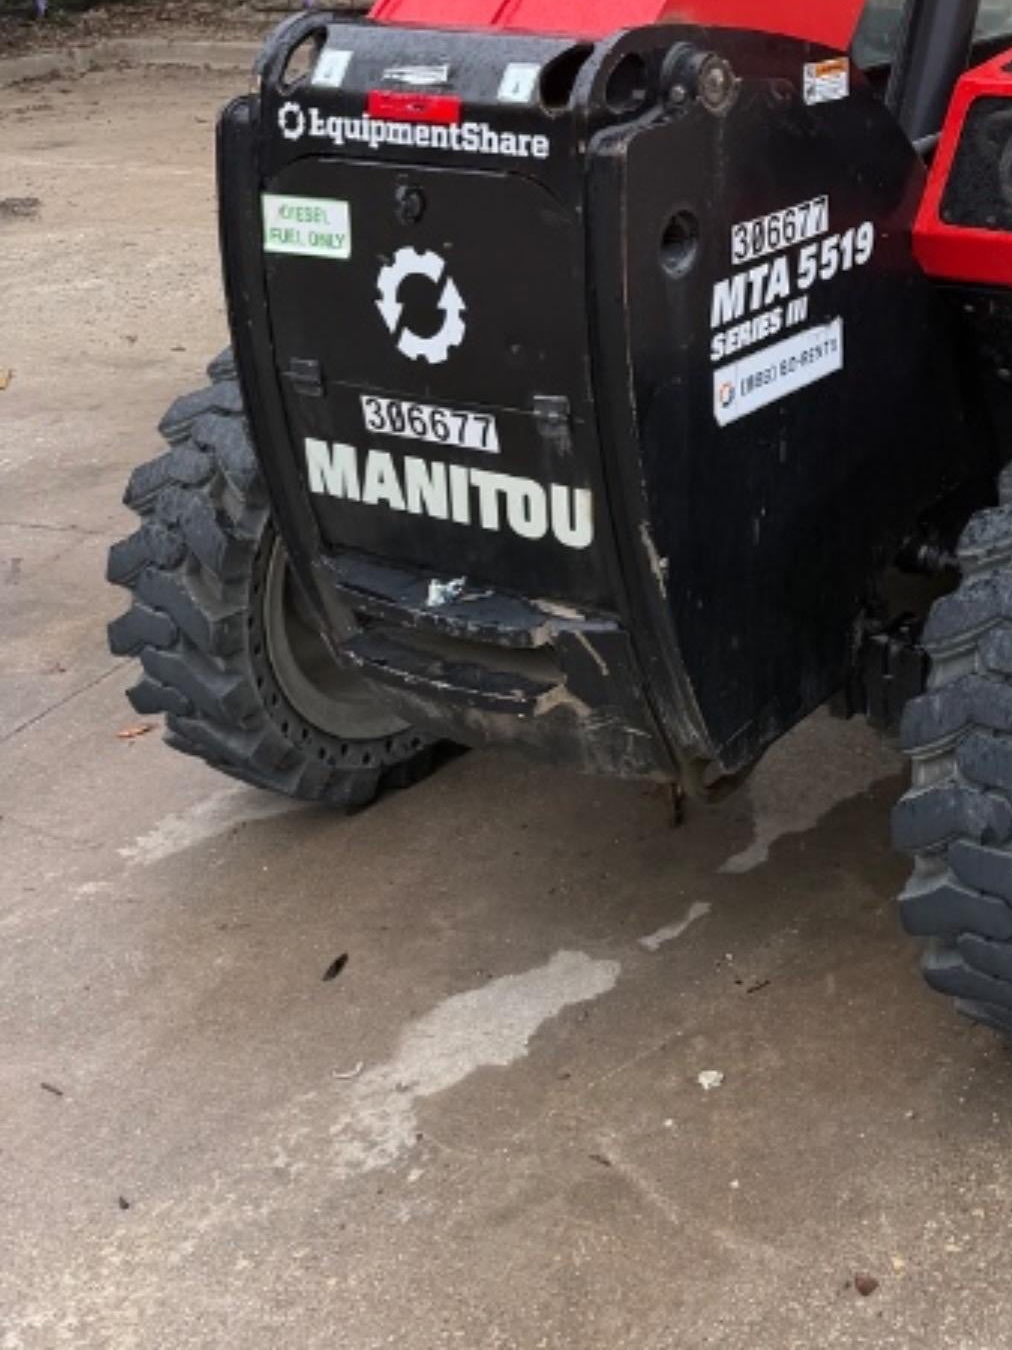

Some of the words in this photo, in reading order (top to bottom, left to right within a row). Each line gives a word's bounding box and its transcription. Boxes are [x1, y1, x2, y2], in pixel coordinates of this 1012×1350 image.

[309, 107, 549, 159] EquipmentShare
[270, 227, 306, 247] FUEL
[309, 231, 345, 250] ONLY
[279, 204, 330, 226] DIESEL
[733, 196, 827, 261] 306677
[710, 254, 790, 329] MTA
[797, 220, 875, 291] 5519
[710, 306, 784, 363] SERIES
[364, 396, 493, 449] 306677
[304, 437, 595, 550] MANITOU
